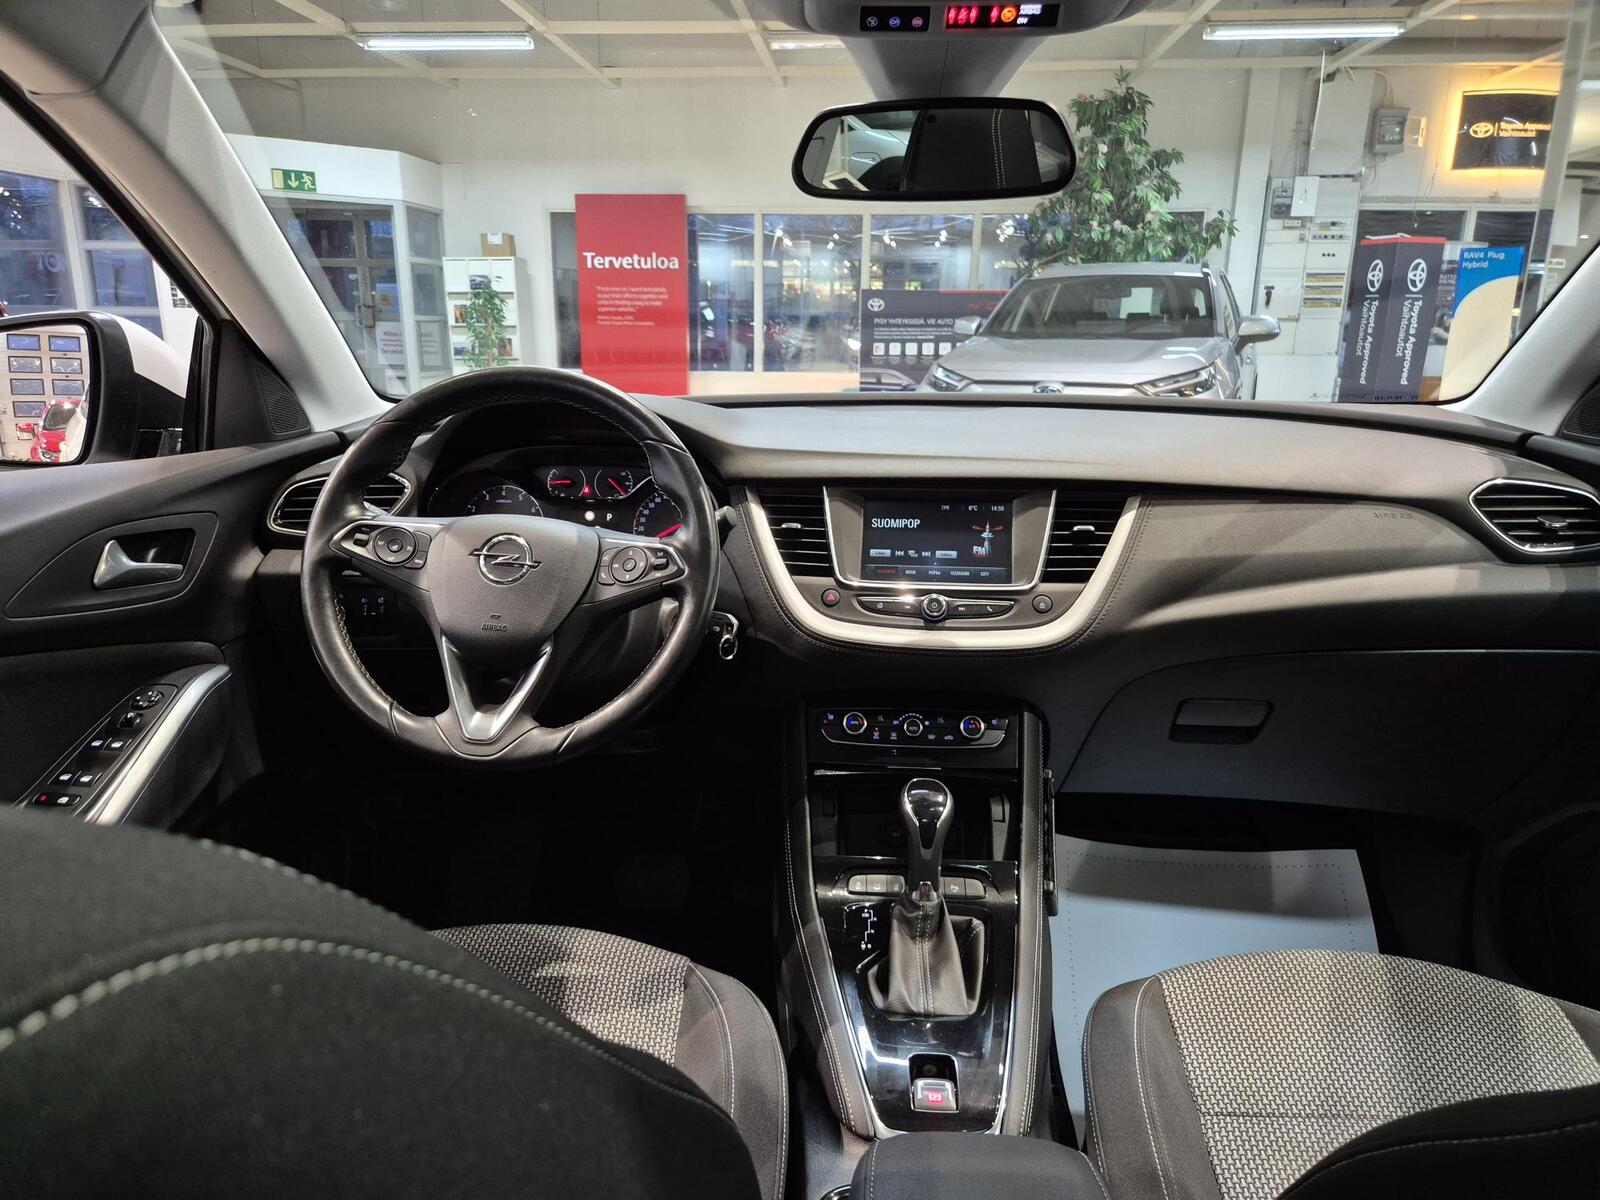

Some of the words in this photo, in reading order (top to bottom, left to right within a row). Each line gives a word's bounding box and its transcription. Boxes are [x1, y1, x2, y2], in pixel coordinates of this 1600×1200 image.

[582, 252, 680, 269] Tervetuloa
[1462, 260, 1489, 269] Hybrid
[1463, 251, 1484, 259] RAV4
[1487, 251, 1505, 260] Plug
[1356, 299, 1371, 357] Vaihtoautot
[1367, 299, 1379, 334] Toyota
[1395, 299, 1412, 358] Vaihtoautot
[1409, 299, 1423, 334] Toyota
[1359, 335, 1373, 385] Approved
[1400, 335, 1416, 385] Approved
[606, 513, 612, 521] P
[871, 518, 921, 529] SUOMIPOP
[481, 623, 507, 632] AIRBAG
